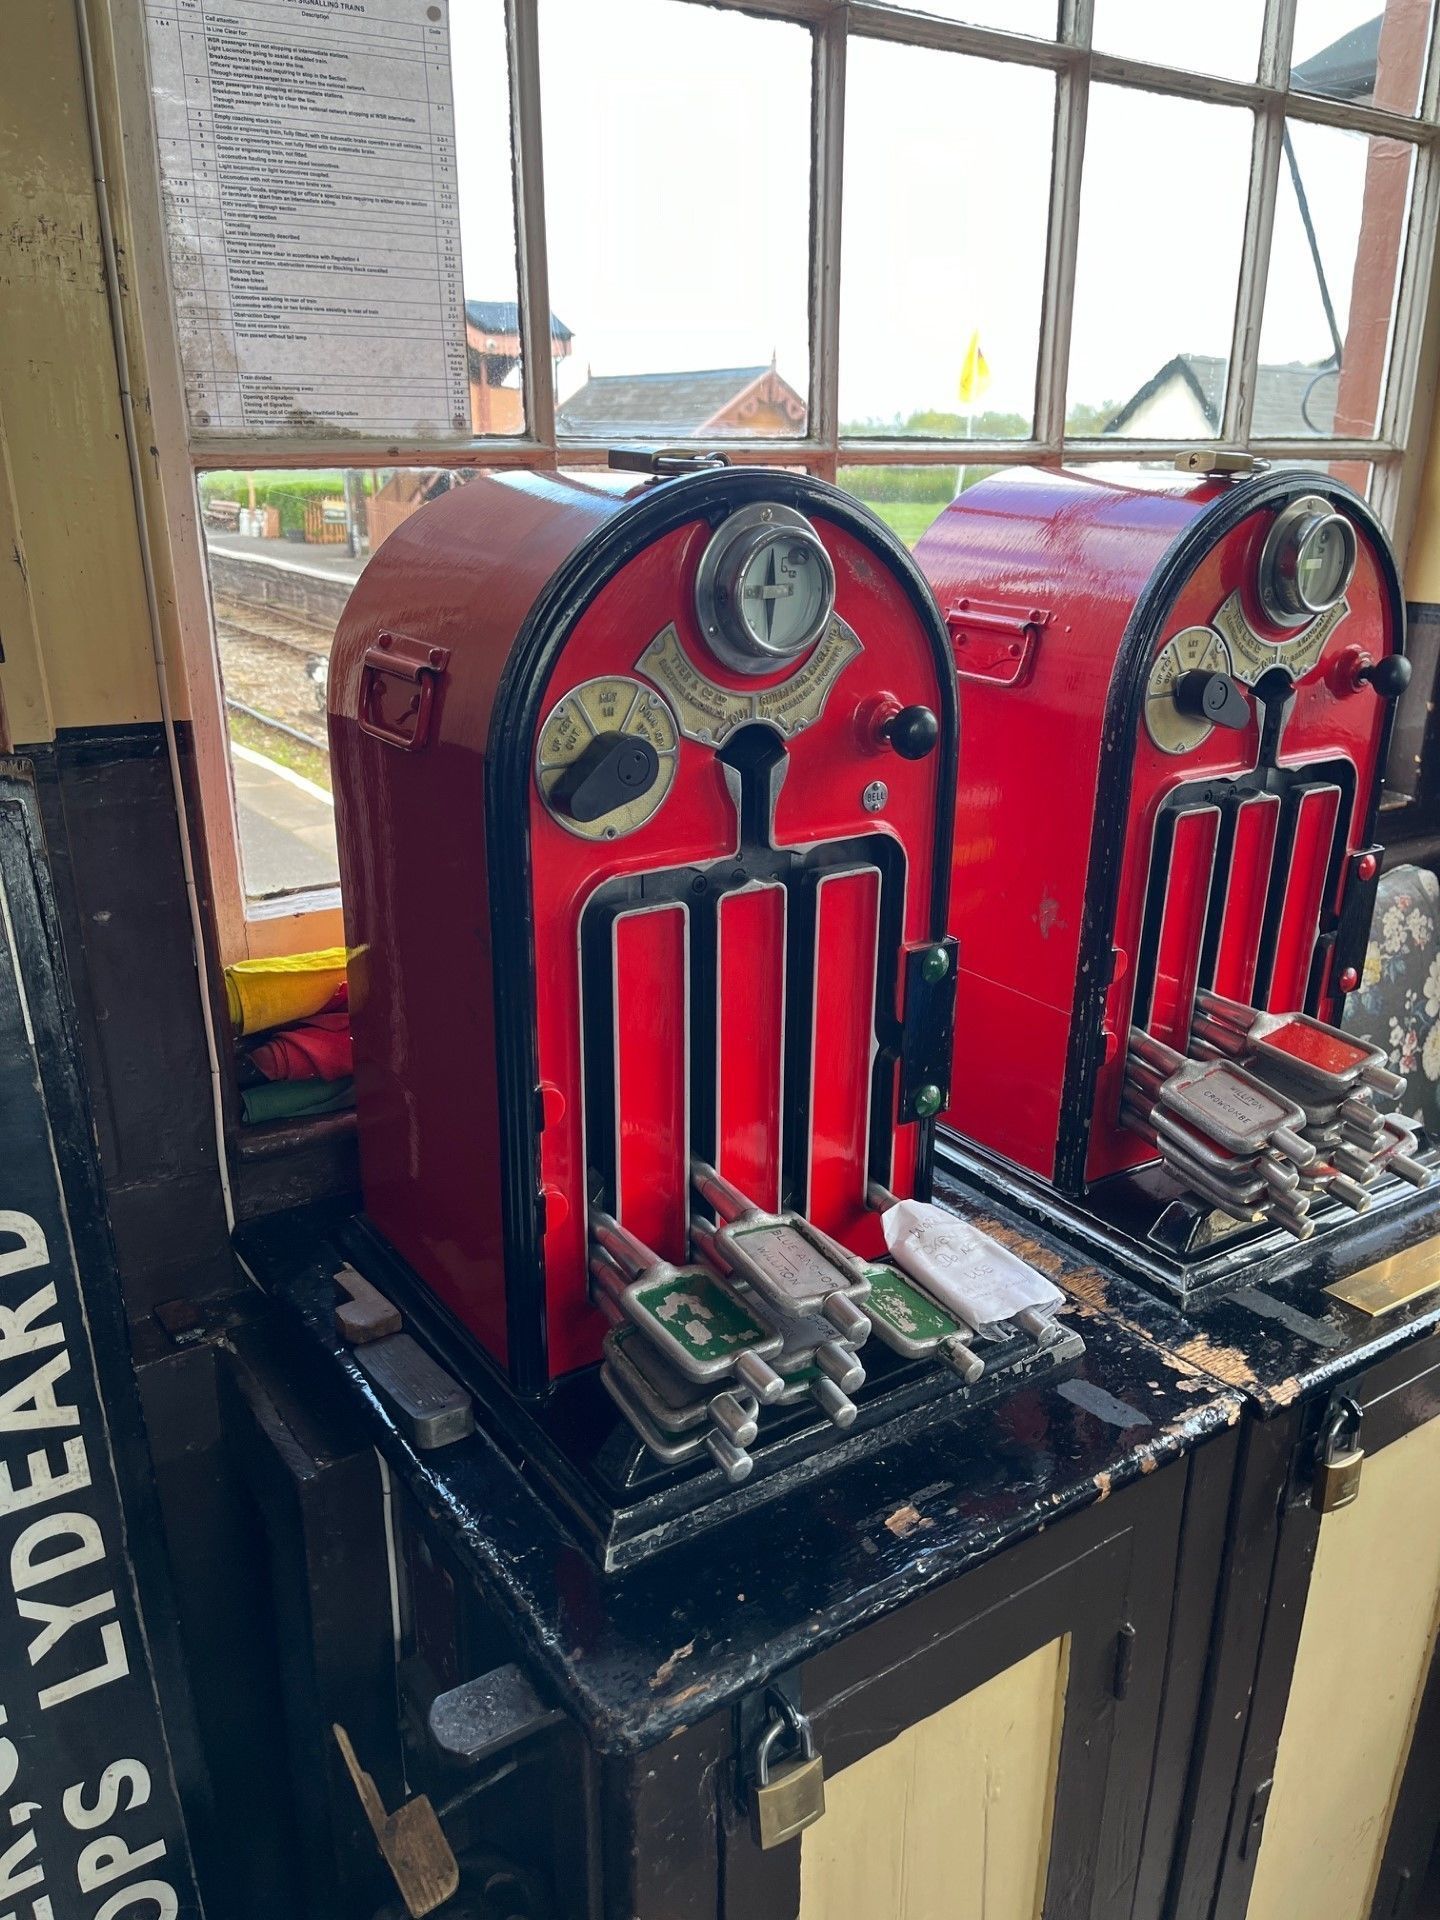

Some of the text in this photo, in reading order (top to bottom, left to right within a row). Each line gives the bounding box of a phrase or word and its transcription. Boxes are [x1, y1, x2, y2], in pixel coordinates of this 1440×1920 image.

[216, 16, 239, 24] attention
[301, 10, 329, 20] Description
[558, 717, 573, 736] KEY
[565, 727, 581, 750] OUT
[867, 791, 886, 802] BELL
[1203, 1090, 1252, 1124] CROWCOMBE
[1230, 1086, 1265, 1110] WILLITON
[770, 1229, 798, 1250] BLUE
[756, 1245, 798, 1286] WILLITON
[0, 1209, 130, 1710] LYDEARD
